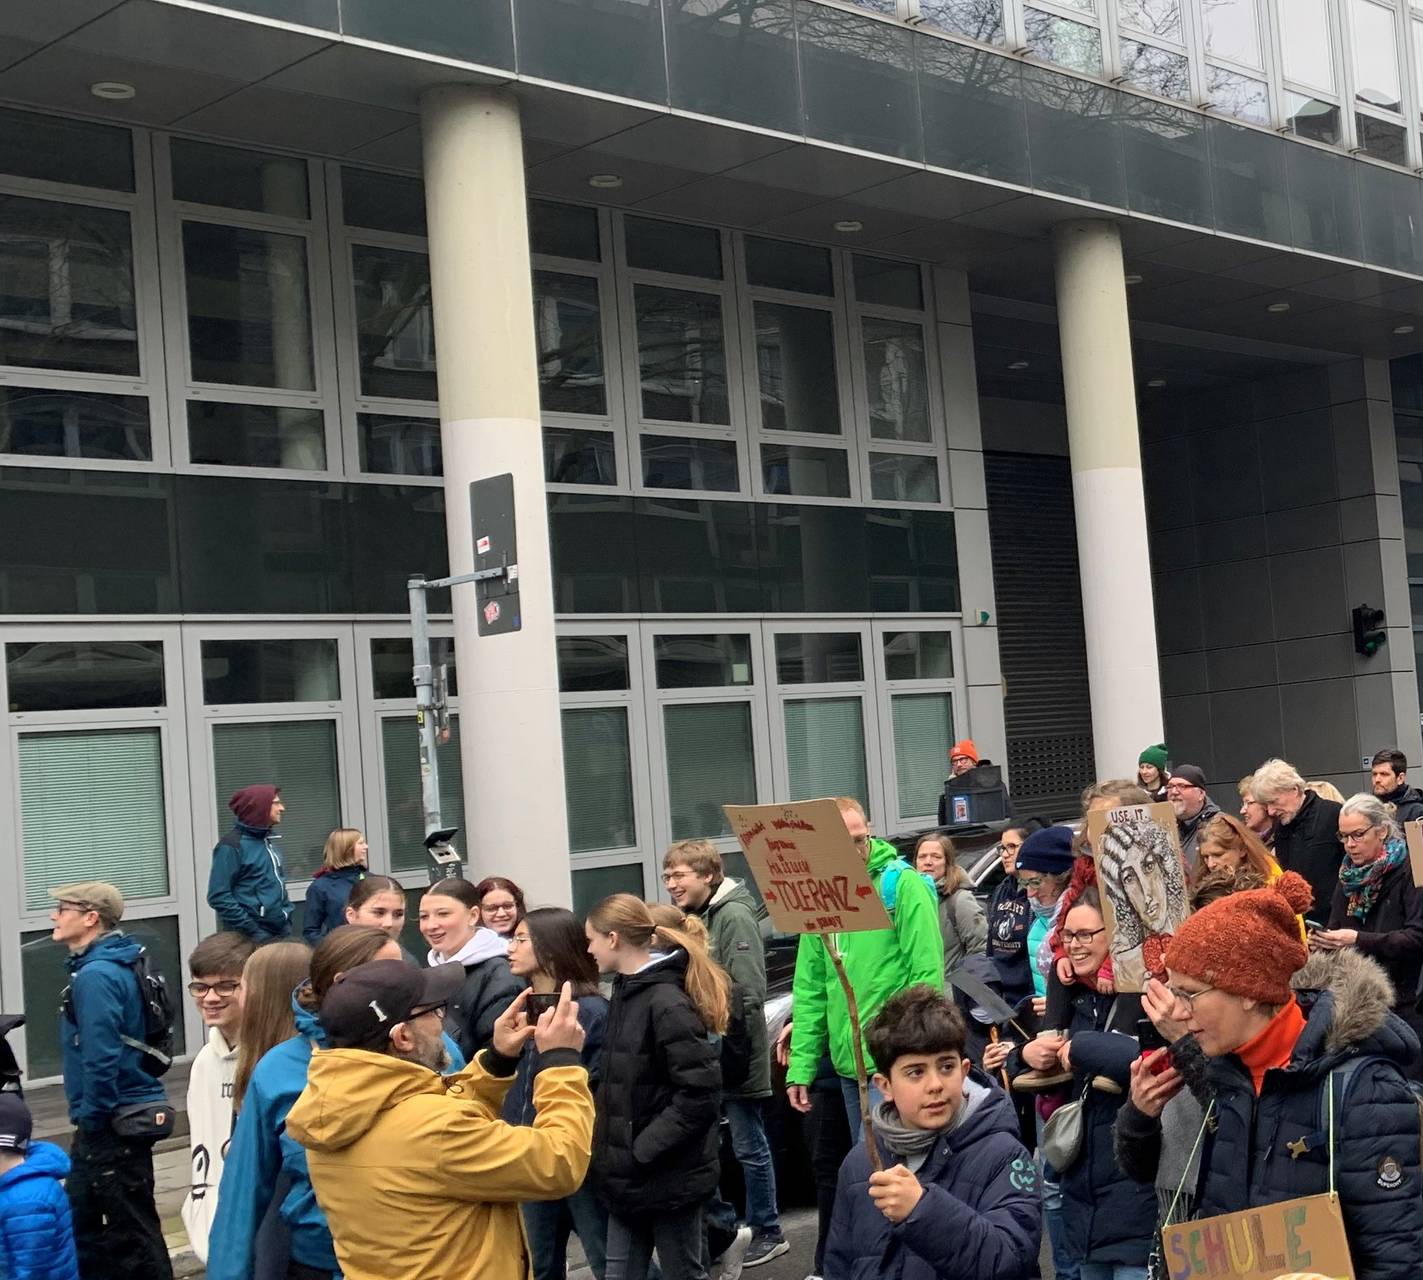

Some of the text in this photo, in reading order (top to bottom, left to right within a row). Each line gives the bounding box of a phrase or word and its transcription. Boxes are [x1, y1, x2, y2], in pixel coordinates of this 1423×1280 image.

[1111, 810, 1131, 824] USE
[769, 875, 860, 913] TOLERANZ
[1170, 1205, 1312, 1280] SCHULE
